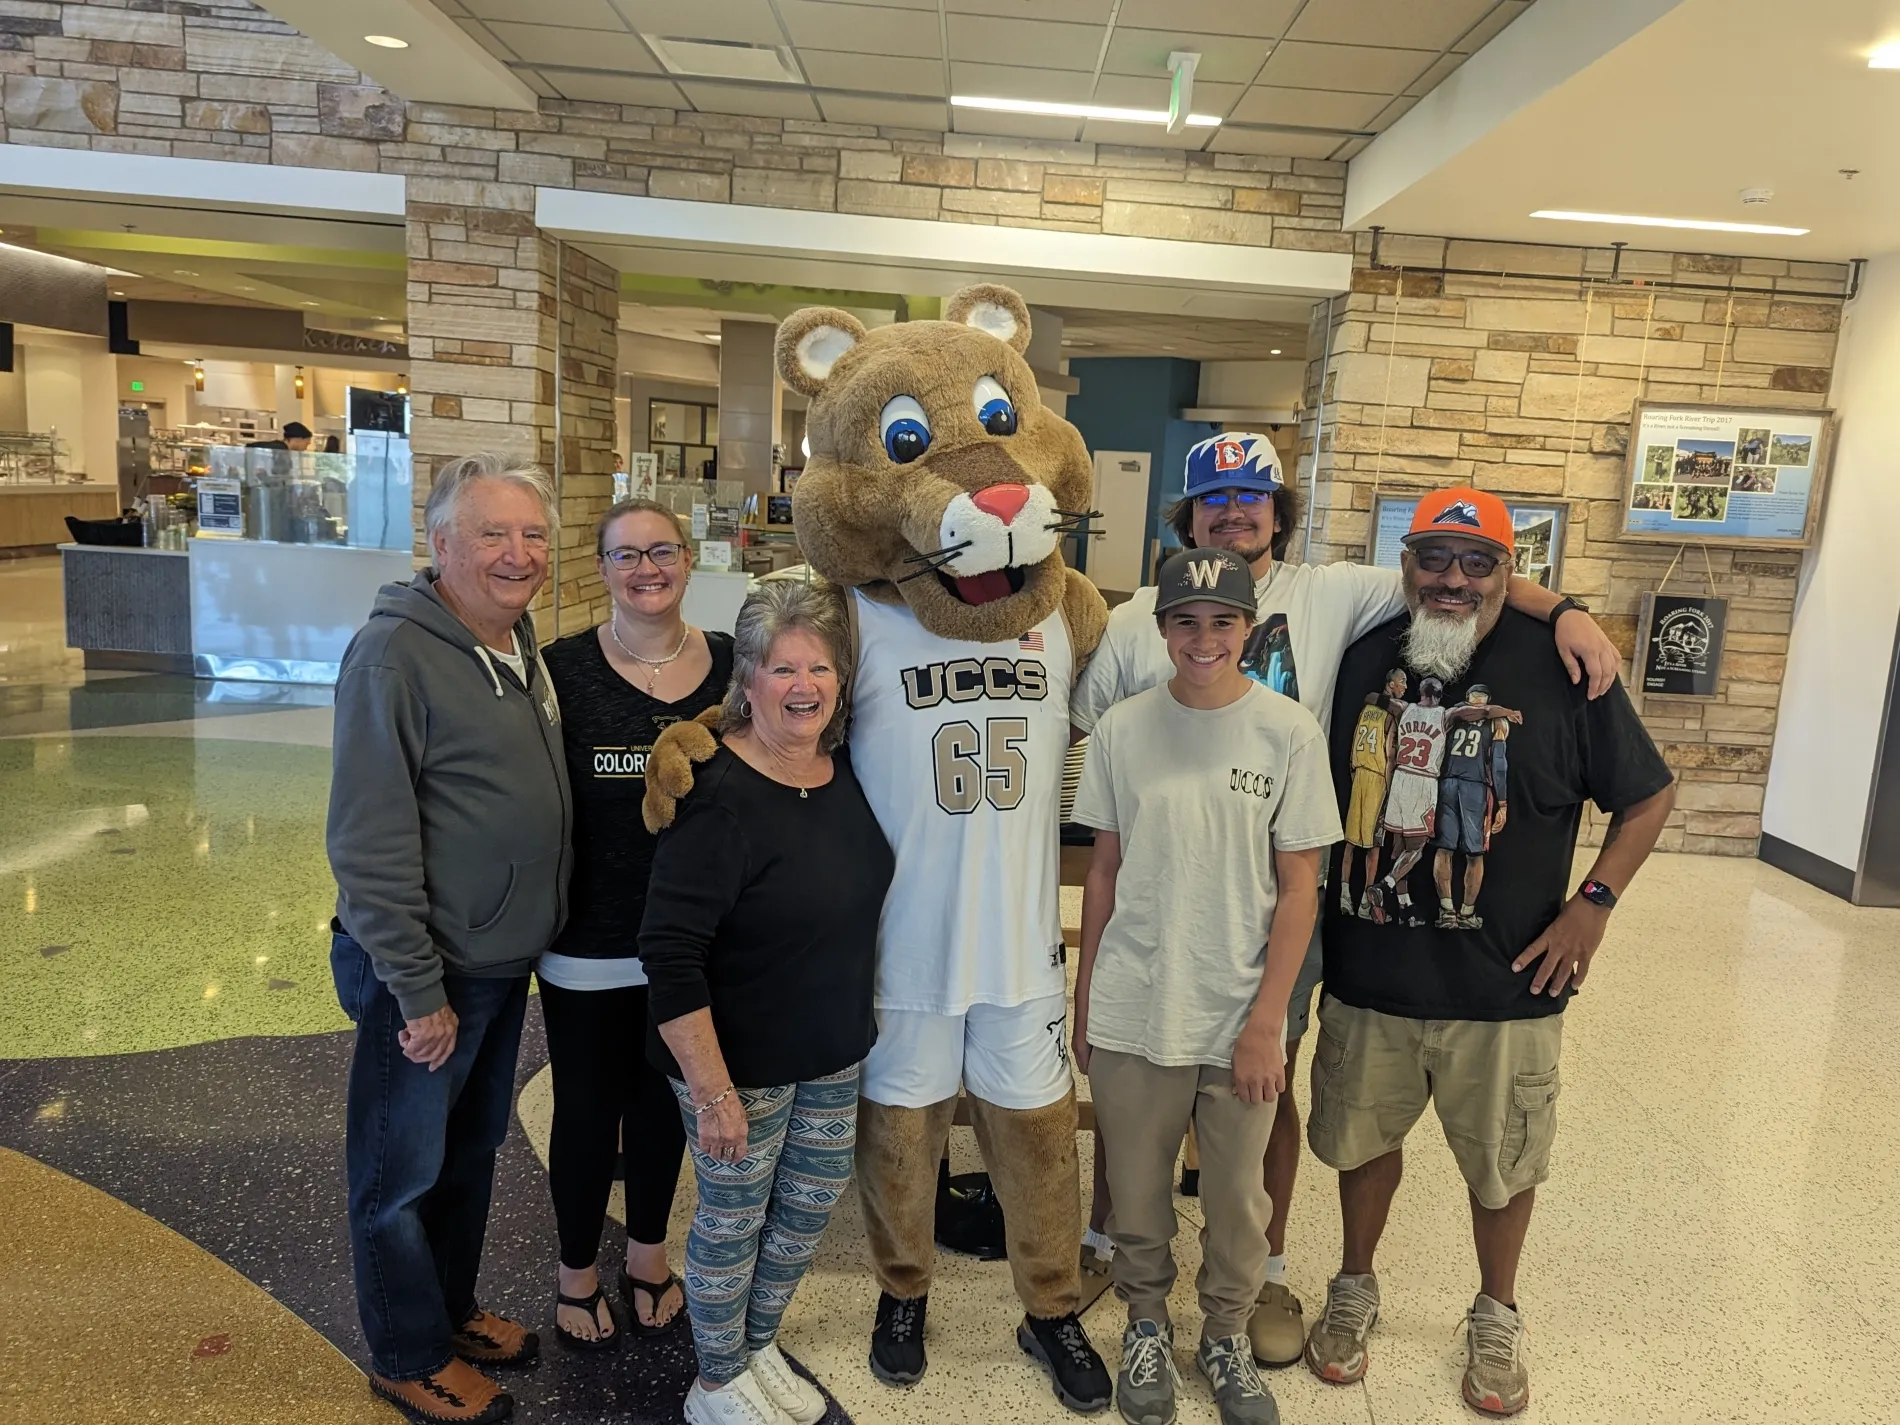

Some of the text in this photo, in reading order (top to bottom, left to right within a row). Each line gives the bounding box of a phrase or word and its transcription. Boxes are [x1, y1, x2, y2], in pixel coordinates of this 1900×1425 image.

[1643, 413, 1668, 421] Roaring
[1702, 416, 1716, 424] Trip
[1187, 559, 1223, 590] W
[1659, 606, 1714, 629] ROARING FORK 2017
[900, 657, 1048, 710] UCCS
[1356, 725, 1377, 754] 24
[1400, 721, 1441, 740] JORDAN
[1450, 729, 1481, 757] 23
[932, 717, 1028, 815] 65
[1397, 737, 1432, 767] 23
[1230, 768, 1274, 799] UCCS
